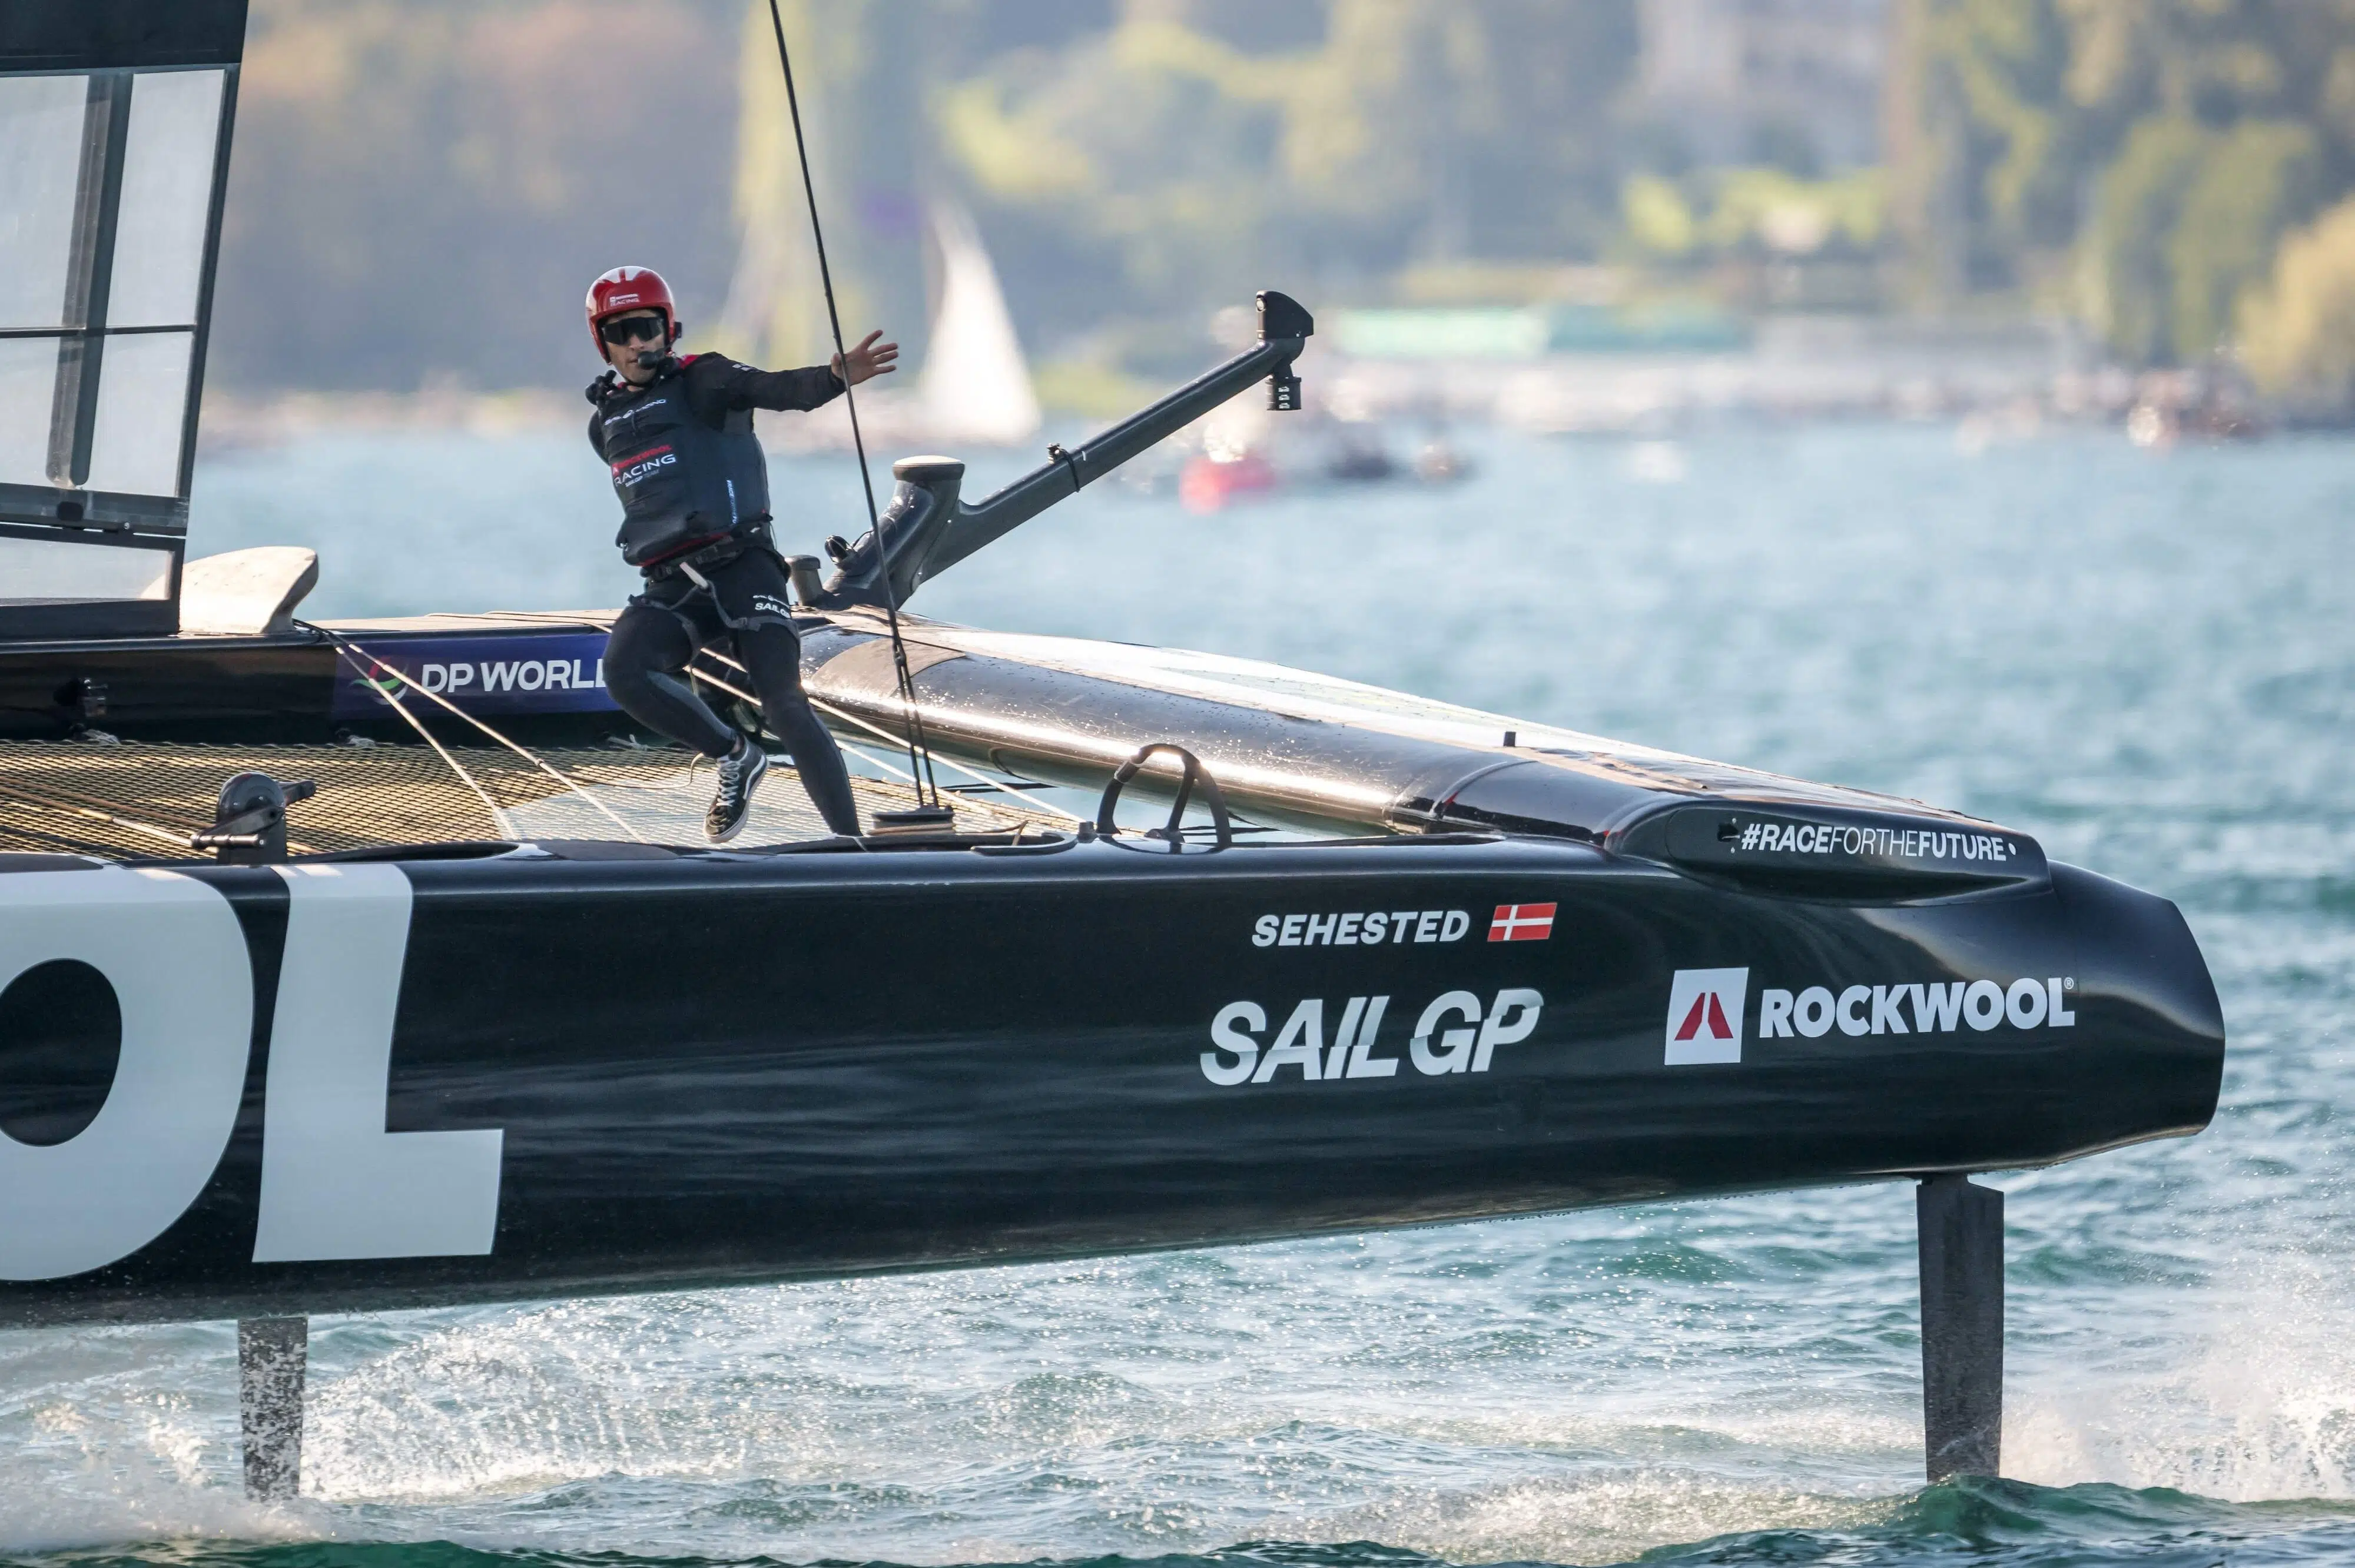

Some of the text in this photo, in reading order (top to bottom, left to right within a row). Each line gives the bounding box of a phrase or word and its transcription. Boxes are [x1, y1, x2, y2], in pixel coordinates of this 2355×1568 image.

[614, 454, 676, 487] RACING
[421, 663, 474, 693] DP
[1741, 823, 2006, 861] #RACEFORTHEFUTURE
[1252, 911, 1470, 947] SEHESTED
